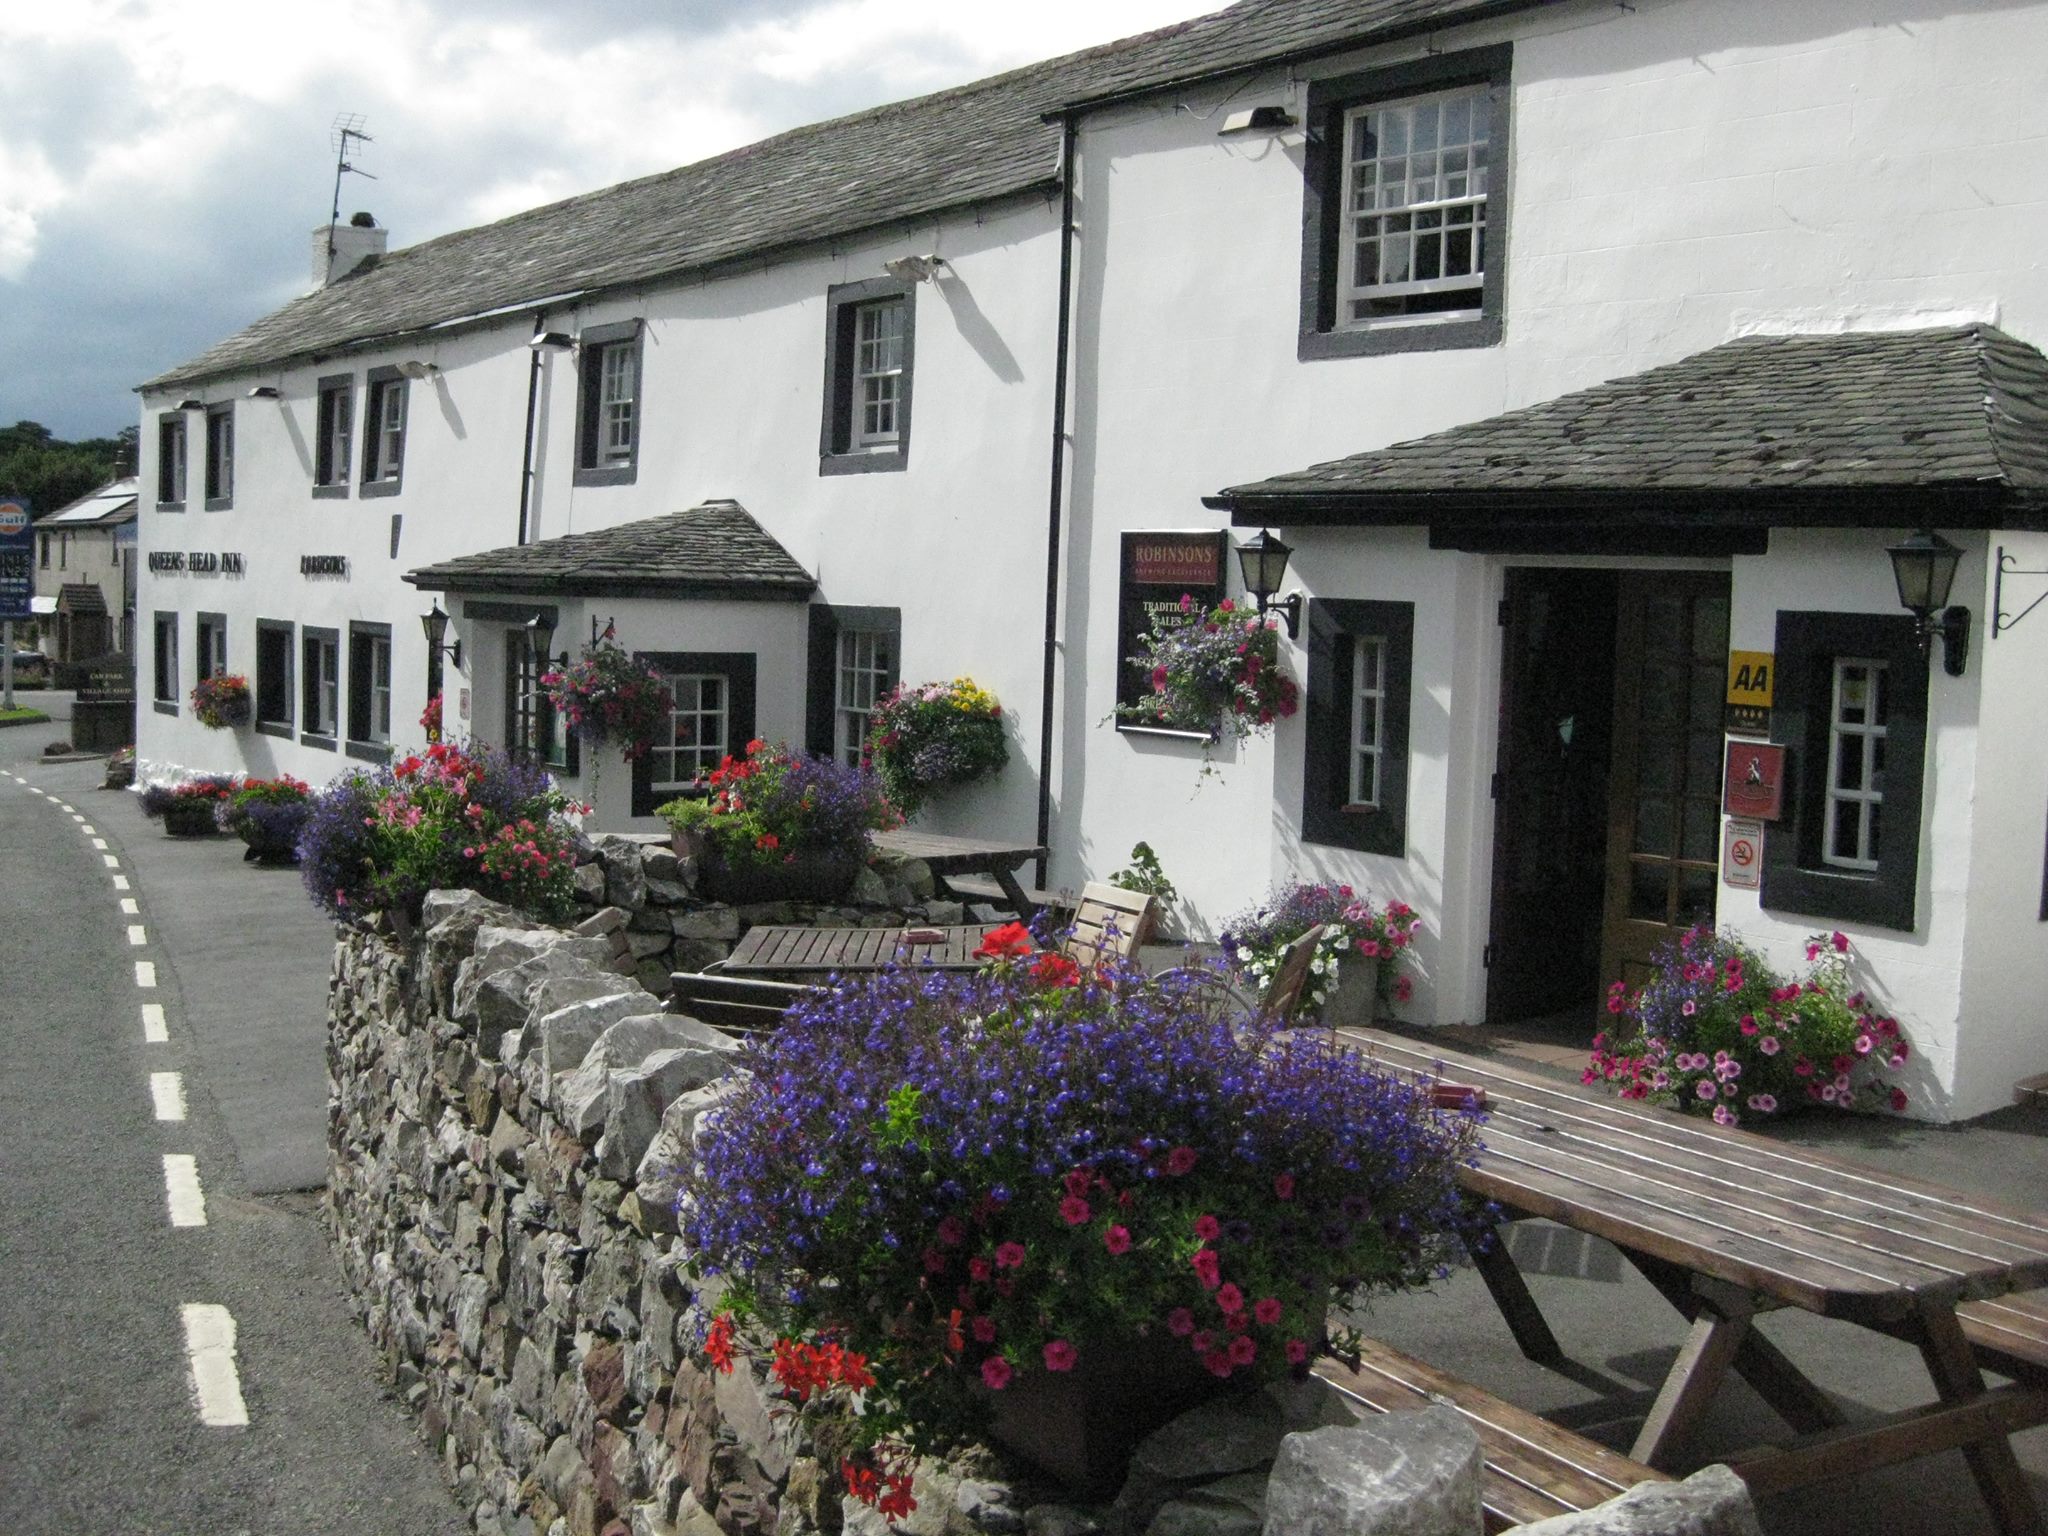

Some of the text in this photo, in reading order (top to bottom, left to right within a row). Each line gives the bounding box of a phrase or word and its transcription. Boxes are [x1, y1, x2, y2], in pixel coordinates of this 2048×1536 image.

[147, 551, 242, 574] QUEENS HEAD INN
[1136, 545, 1212, 563] ROBINSONS
[1160, 616, 1182, 626] ALES
[1732, 664, 1768, 692] AA
